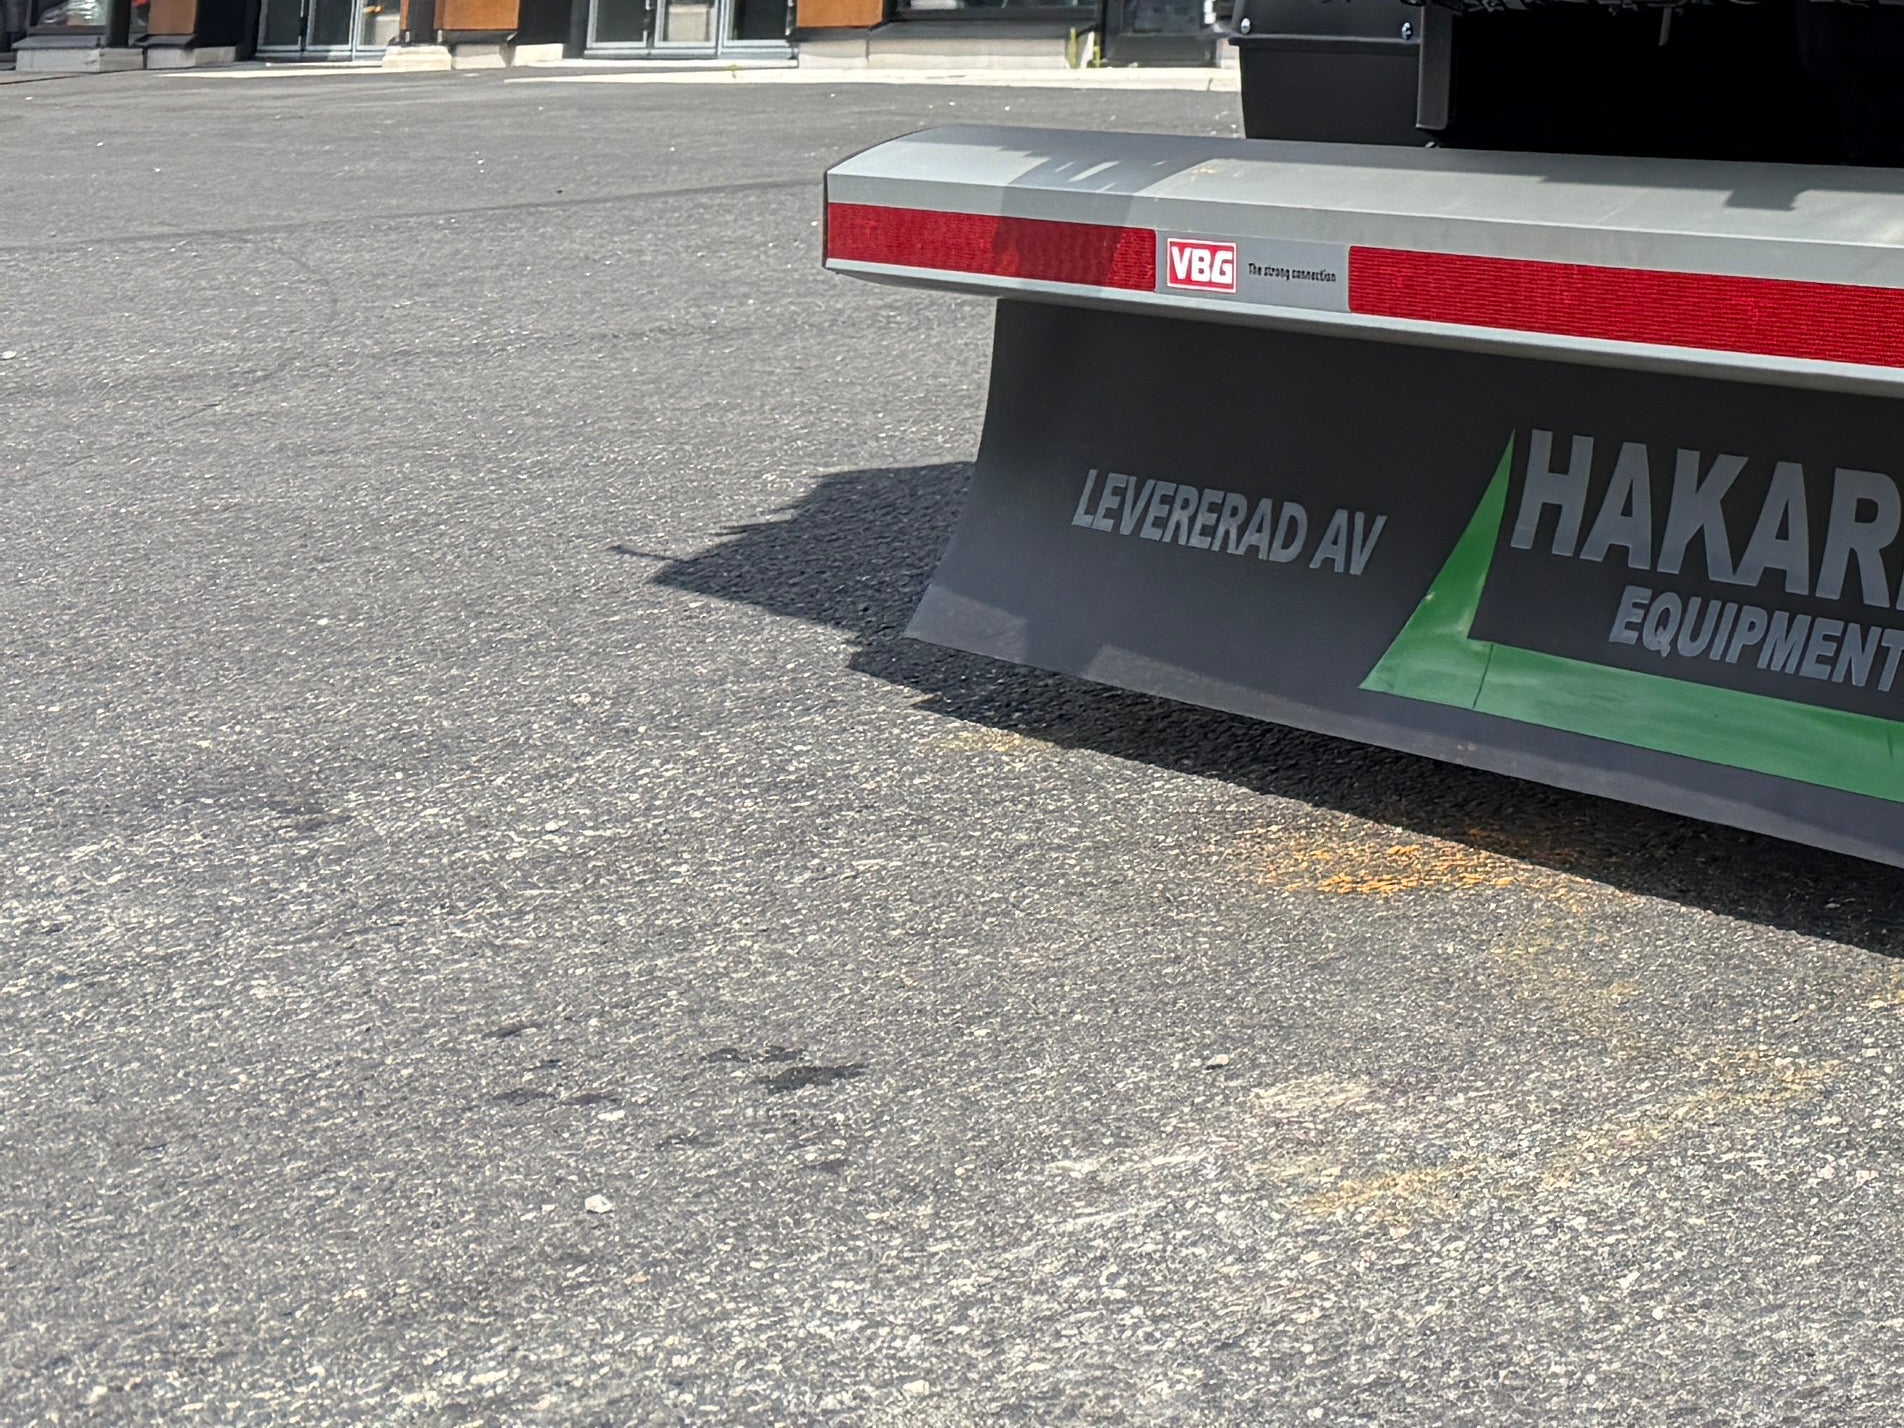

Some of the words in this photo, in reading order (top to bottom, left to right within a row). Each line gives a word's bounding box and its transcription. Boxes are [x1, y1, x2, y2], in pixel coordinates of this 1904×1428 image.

[1171, 246, 1233, 284] VBG
[1071, 468, 1308, 565] LEVERERAD
[1309, 508, 1386, 576] AV
